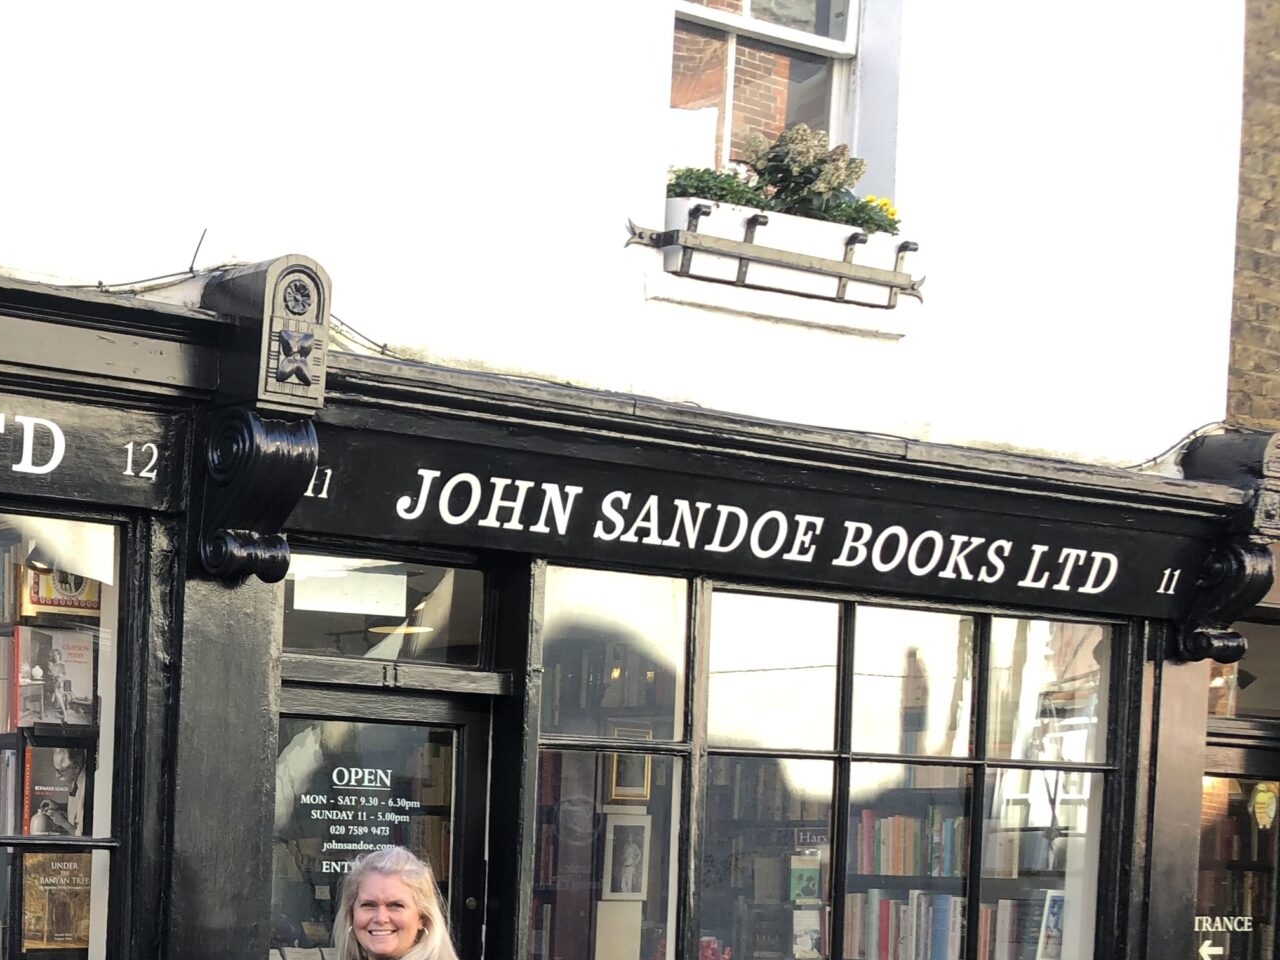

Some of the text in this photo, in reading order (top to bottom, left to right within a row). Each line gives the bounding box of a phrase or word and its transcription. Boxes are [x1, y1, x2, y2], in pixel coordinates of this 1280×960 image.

[123, 440, 160, 483] 12
[396, 468, 1119, 595] JOHN SANDOE BOOKS LTD
[1156, 568, 1181, 595] 11
[332, 766, 393, 787] OPEN
[300, 794, 327, 805] MON
[337, 795, 357, 806] SAT
[360, 796, 378, 806] 9.30
[388, 798, 420, 810] 6.30pm
[311, 809, 354, 820] SUNDAY
[357, 811, 367, 820] 11
[377, 812, 410, 824] 5.00pm
[329, 825, 389, 836] 020 7589 9473
[322, 840, 396, 852] johnsandoe.com
[51, 862, 78, 870] UNDER
